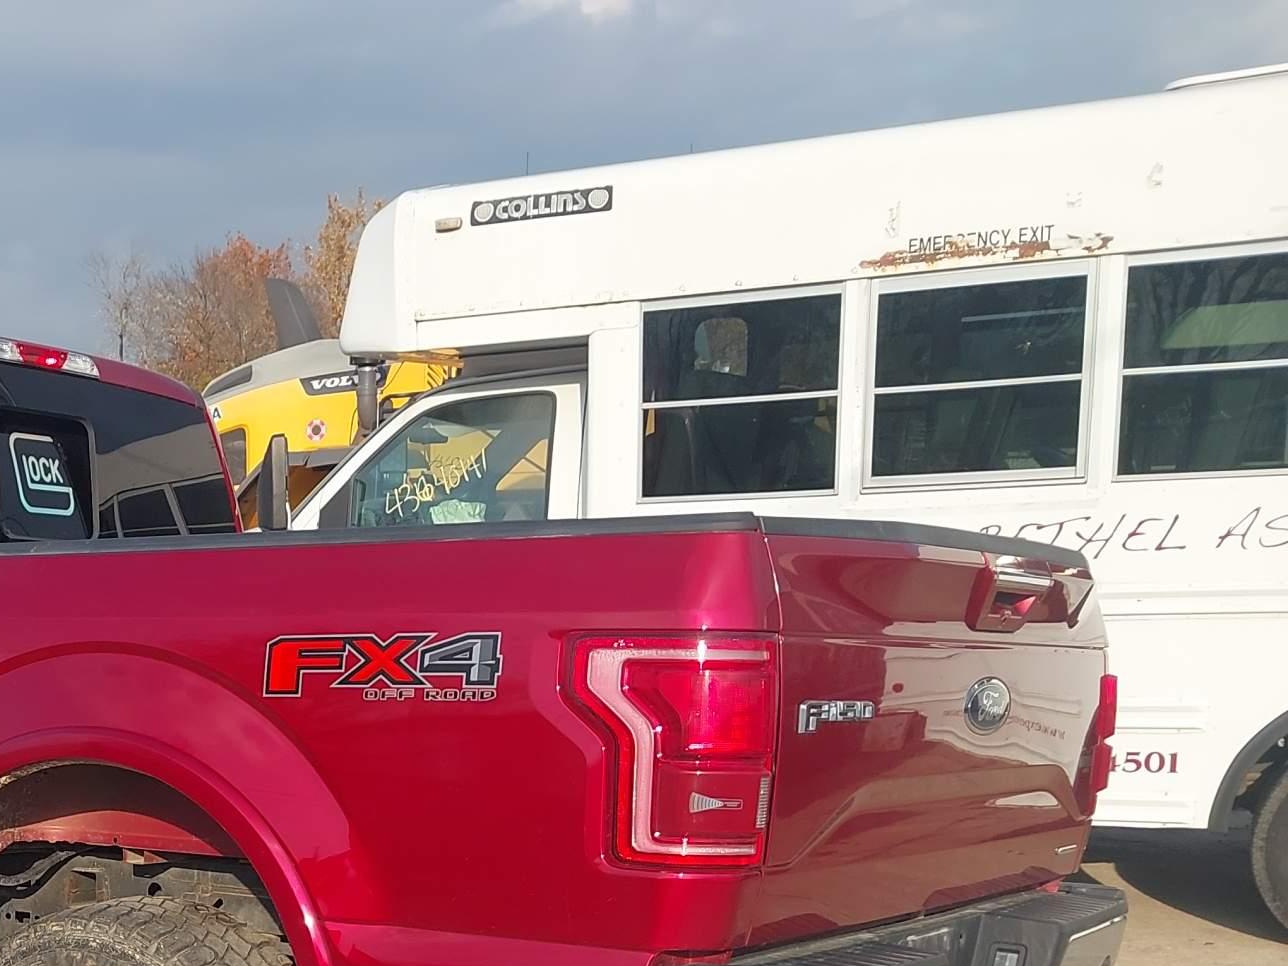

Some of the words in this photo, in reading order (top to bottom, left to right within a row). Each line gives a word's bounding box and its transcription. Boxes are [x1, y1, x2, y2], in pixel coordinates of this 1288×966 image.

[1019, 225, 1055, 244] EXIT
[310, 374, 359, 390] VOL
[263, 632, 502, 697] FX4
[363, 688, 415, 701] OFF
[424, 688, 497, 701] ROAD
